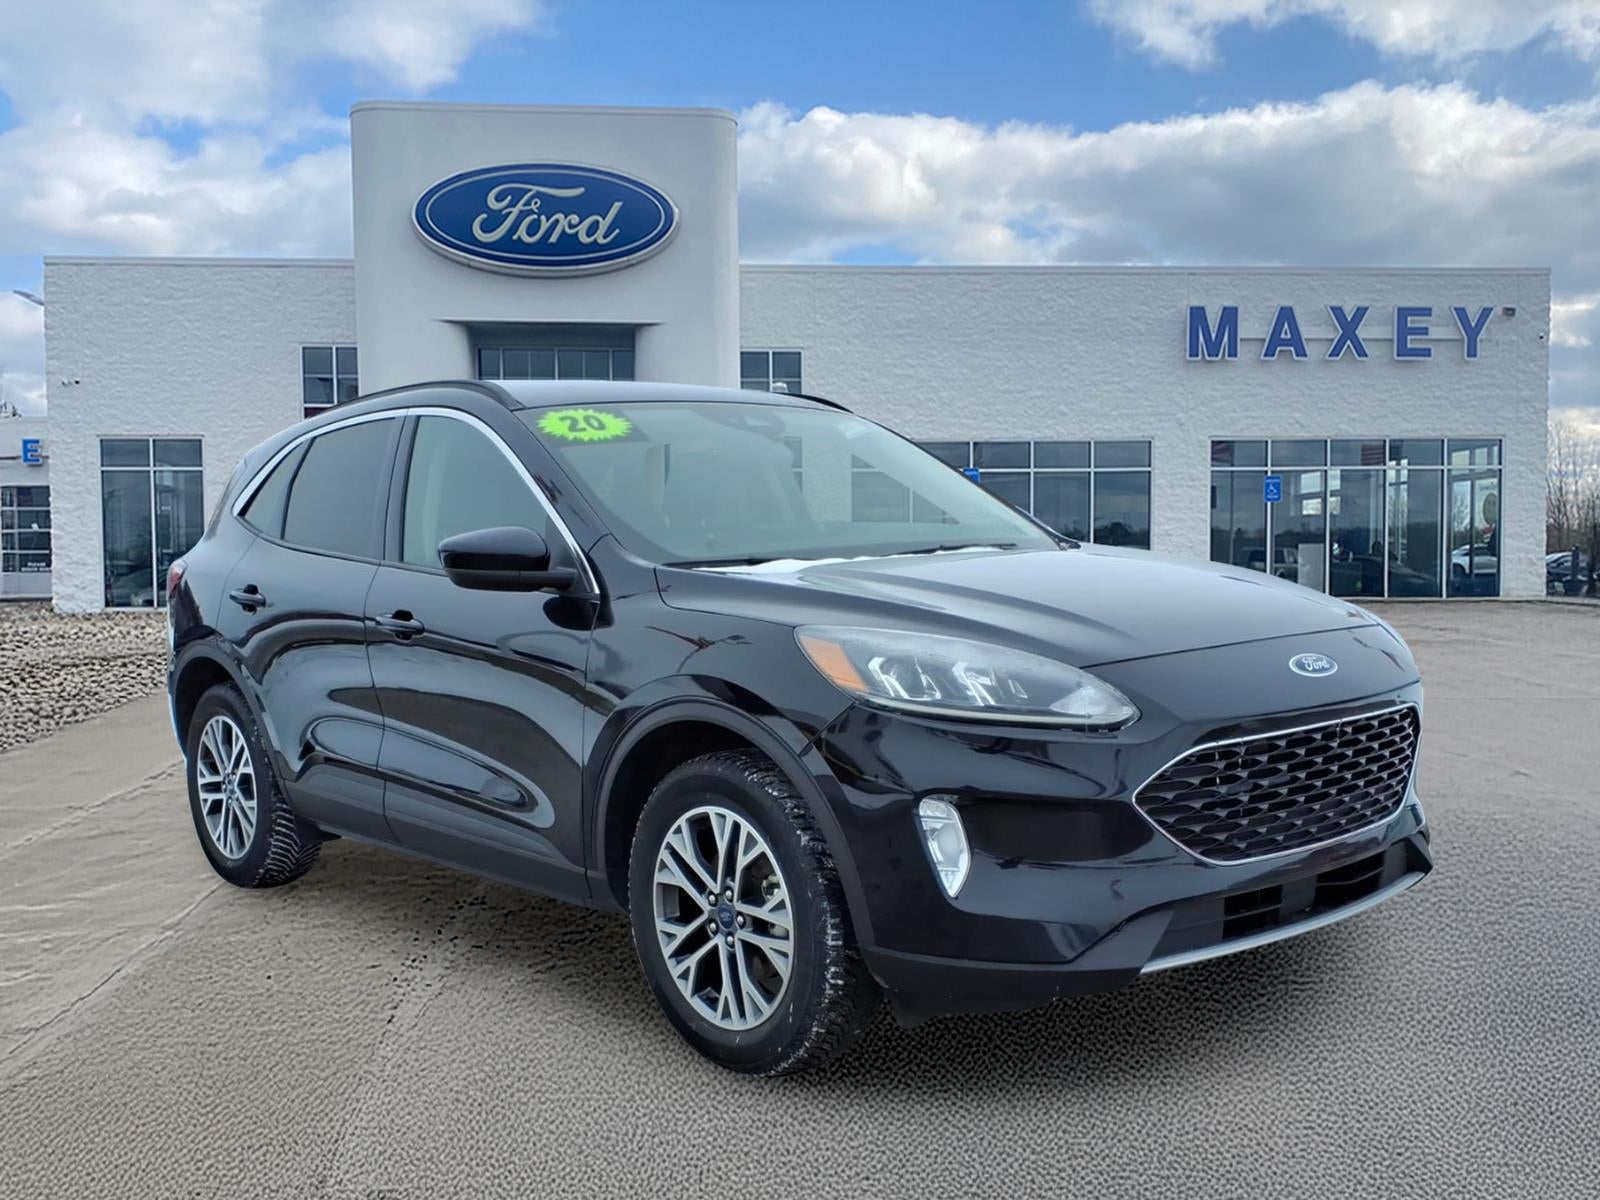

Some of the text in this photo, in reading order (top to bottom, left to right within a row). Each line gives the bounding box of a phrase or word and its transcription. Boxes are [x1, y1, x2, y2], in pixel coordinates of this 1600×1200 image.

[472, 183, 623, 244] Ford
[1187, 305, 1494, 359] MAXEY
[558, 415, 606, 433] 20
[22, 438, 42, 464] E
[1301, 656, 1330, 671] Ford
